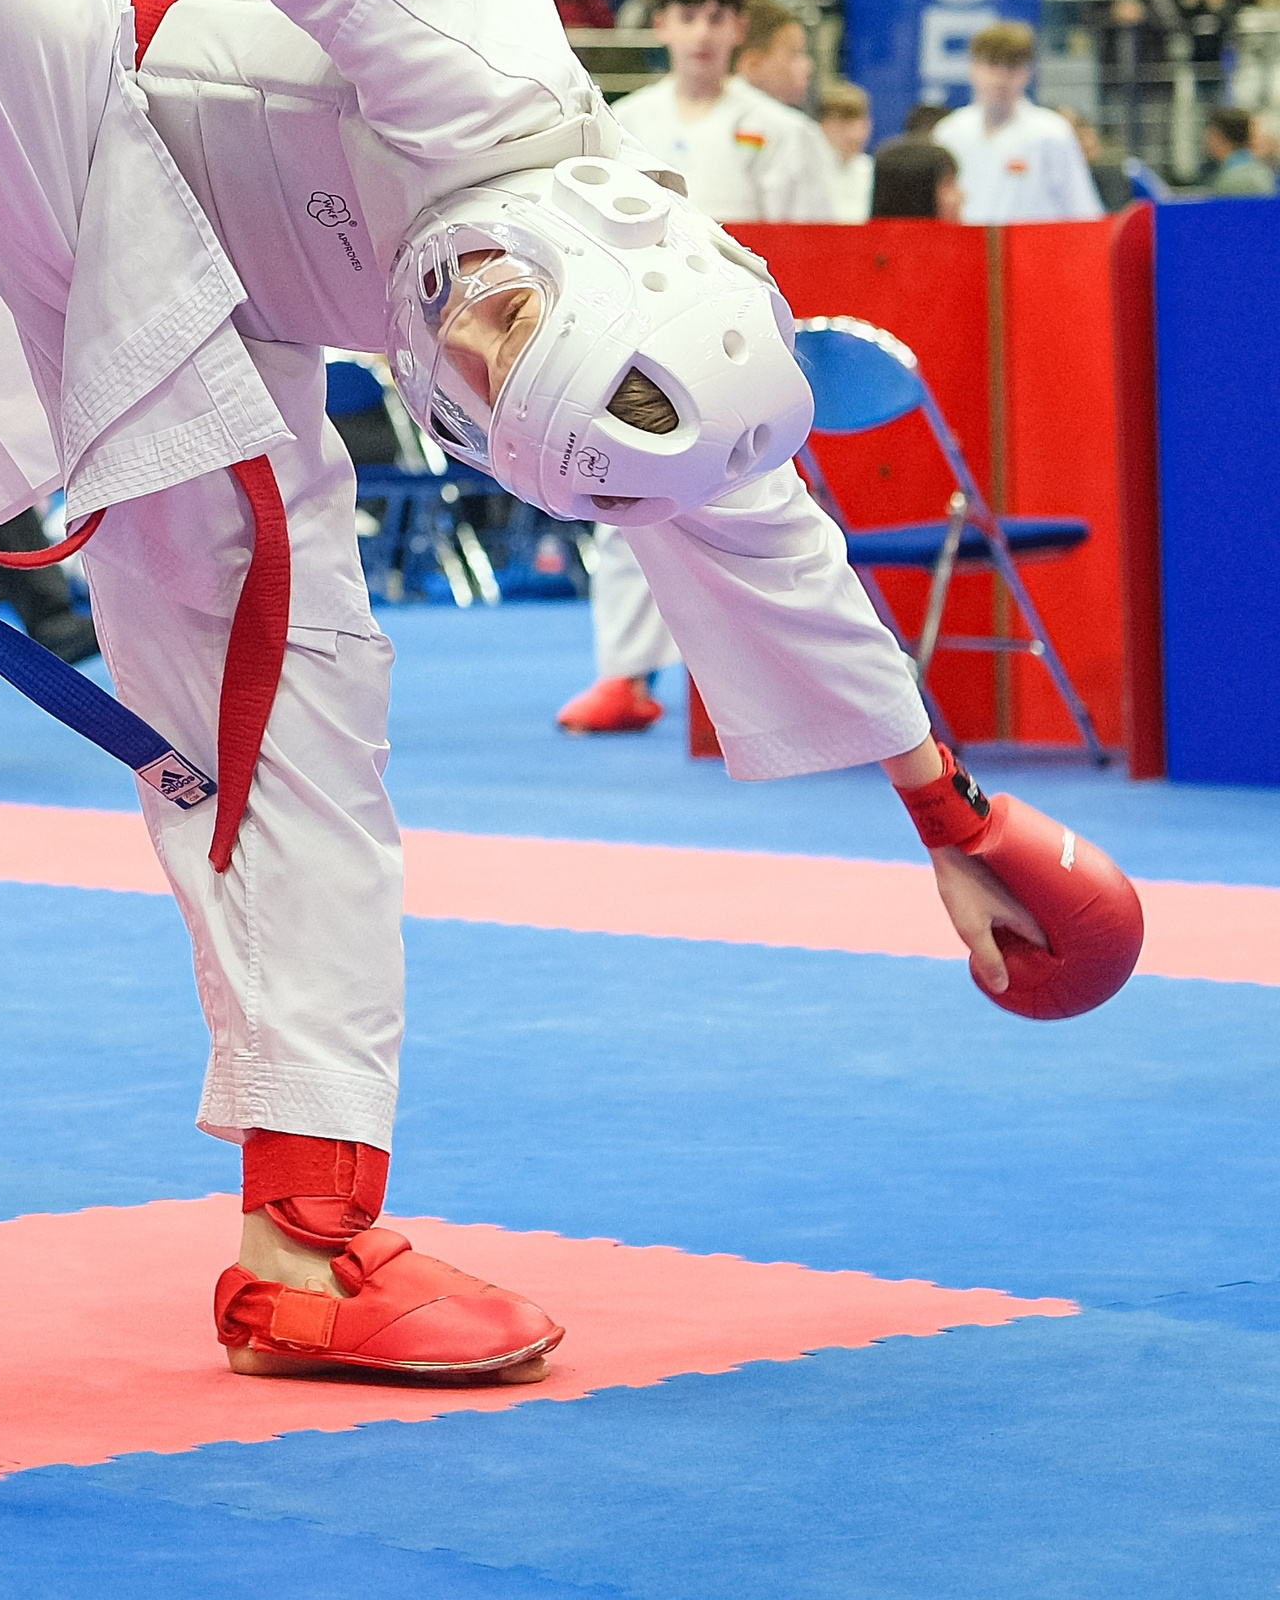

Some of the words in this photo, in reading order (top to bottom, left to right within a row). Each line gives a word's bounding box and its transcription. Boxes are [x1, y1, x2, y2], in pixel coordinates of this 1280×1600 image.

[322, 199, 338, 219] WKF
[337, 232, 363, 272] APPROVED
[559, 431, 577, 476] APPROVED
[162, 775, 196, 795] adidas
